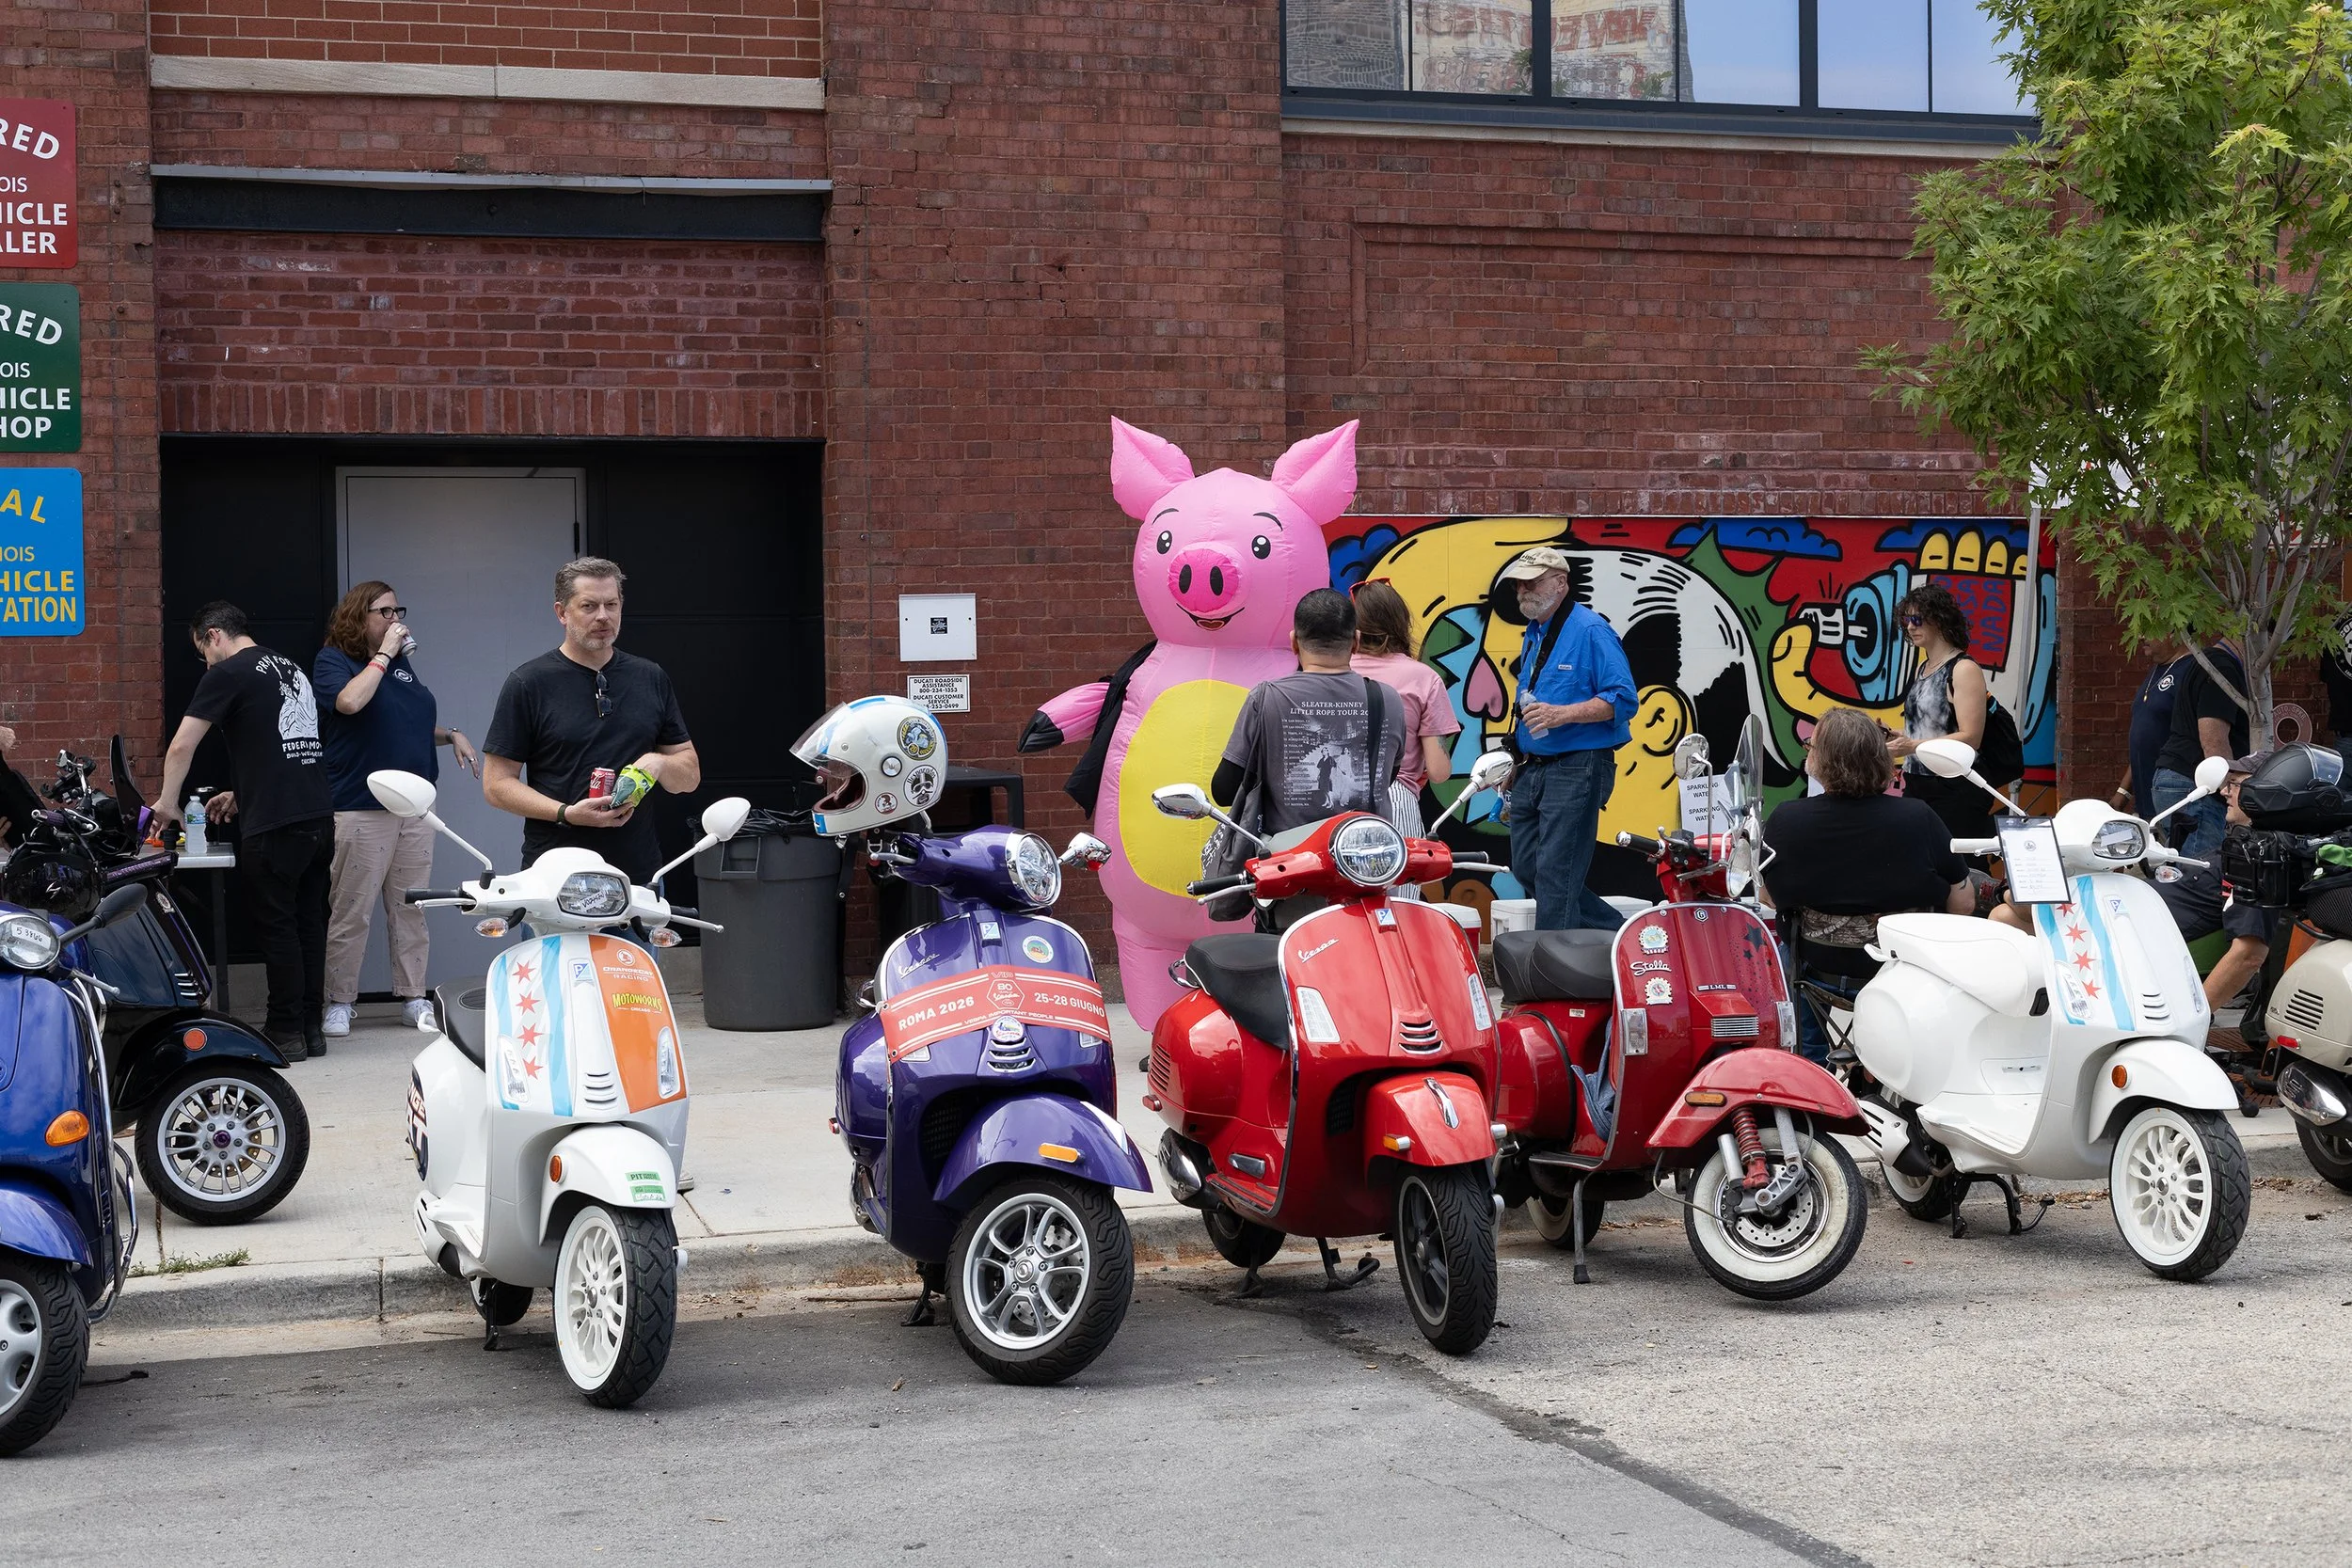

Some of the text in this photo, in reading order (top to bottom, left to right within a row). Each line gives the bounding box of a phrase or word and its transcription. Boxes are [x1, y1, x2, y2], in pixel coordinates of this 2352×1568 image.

[0, 201, 68, 226] ICLE
[0, 230, 58, 254] LER
[0, 546, 35, 562] OIS
[0, 596, 77, 623] ATION
[1979, 579, 2007, 652] NADA
[1688, 806, 1721, 815] SPARKNG
[1298, 938, 1340, 963] Vespa
[612, 974, 649, 982] RACING
[1629, 959, 1672, 976] Stella
[997, 982, 1013, 991] 80
[612, 993, 663, 1012] MOTOWORKS
[1034, 991, 1105, 1019] 25-28 GIUGNO
[898, 996, 976, 1032] ROMA 2026
[963, 1009, 1055, 1028] VESPA IMPORTANT PEOPLE
